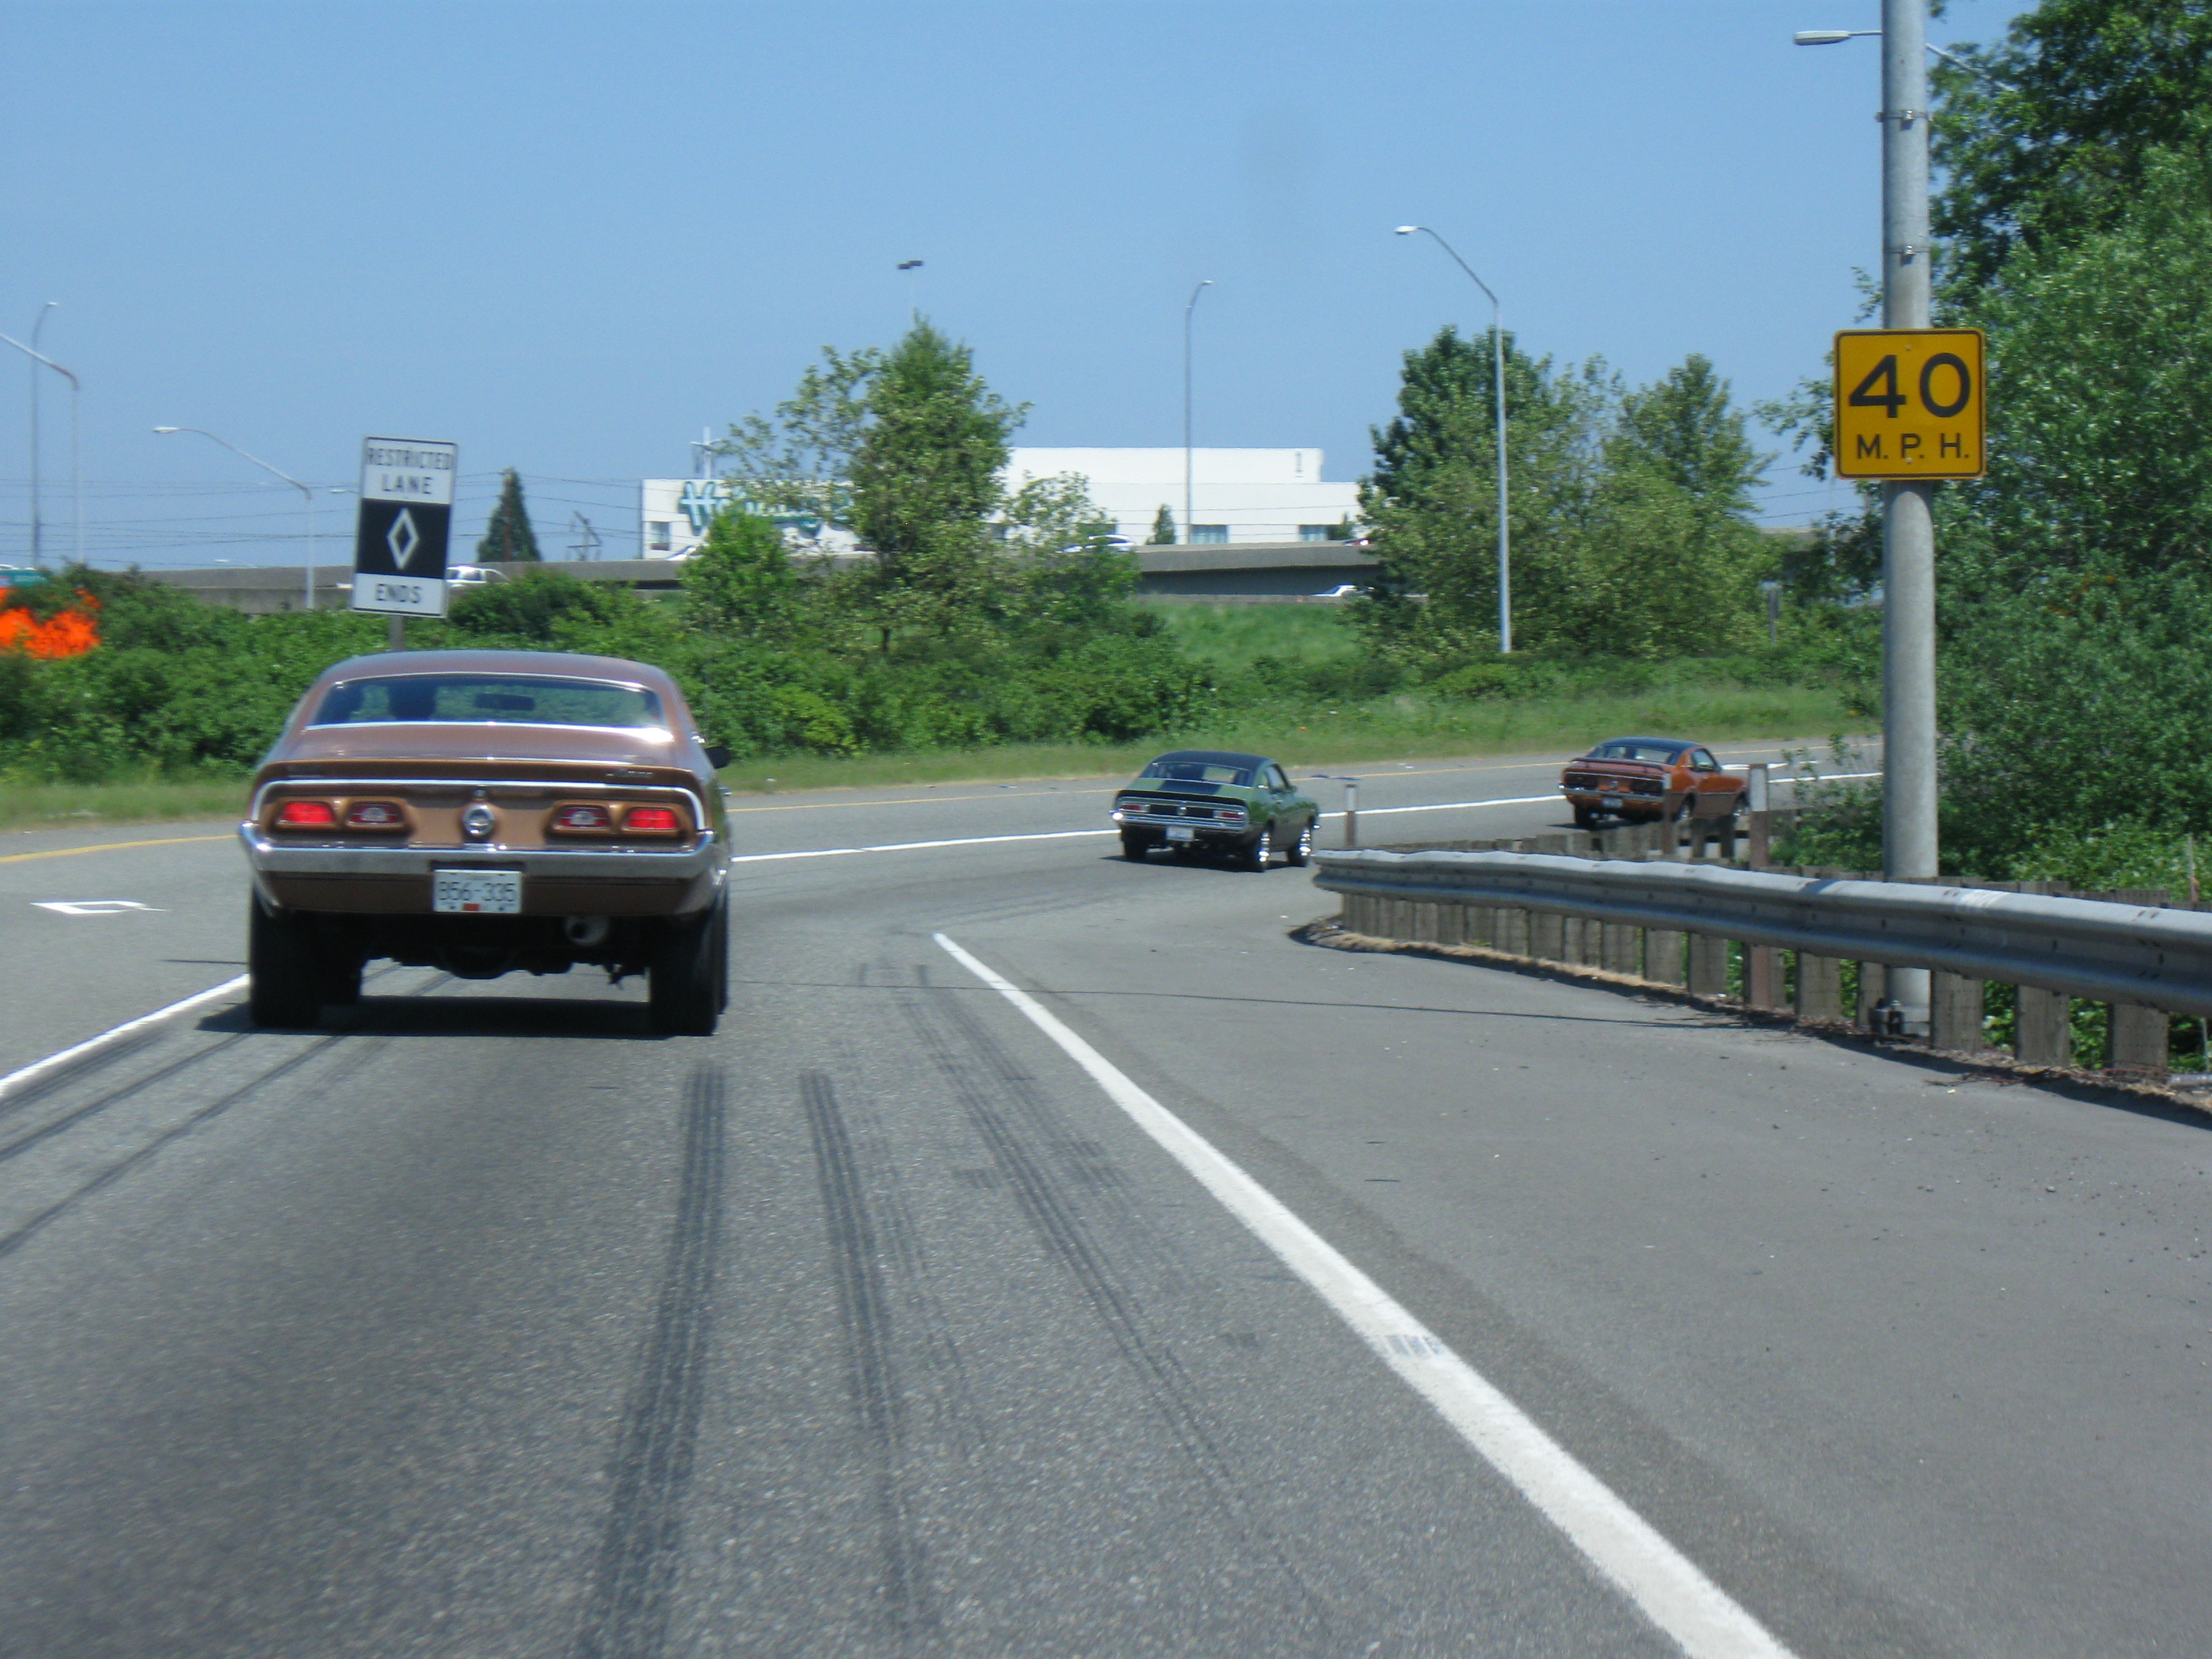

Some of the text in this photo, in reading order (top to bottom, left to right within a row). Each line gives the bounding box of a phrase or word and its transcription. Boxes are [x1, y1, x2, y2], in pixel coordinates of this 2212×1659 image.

[1849, 352, 1971, 419] 40
[381, 476, 432, 495] LANE
[375, 582, 422, 604] ENDS
